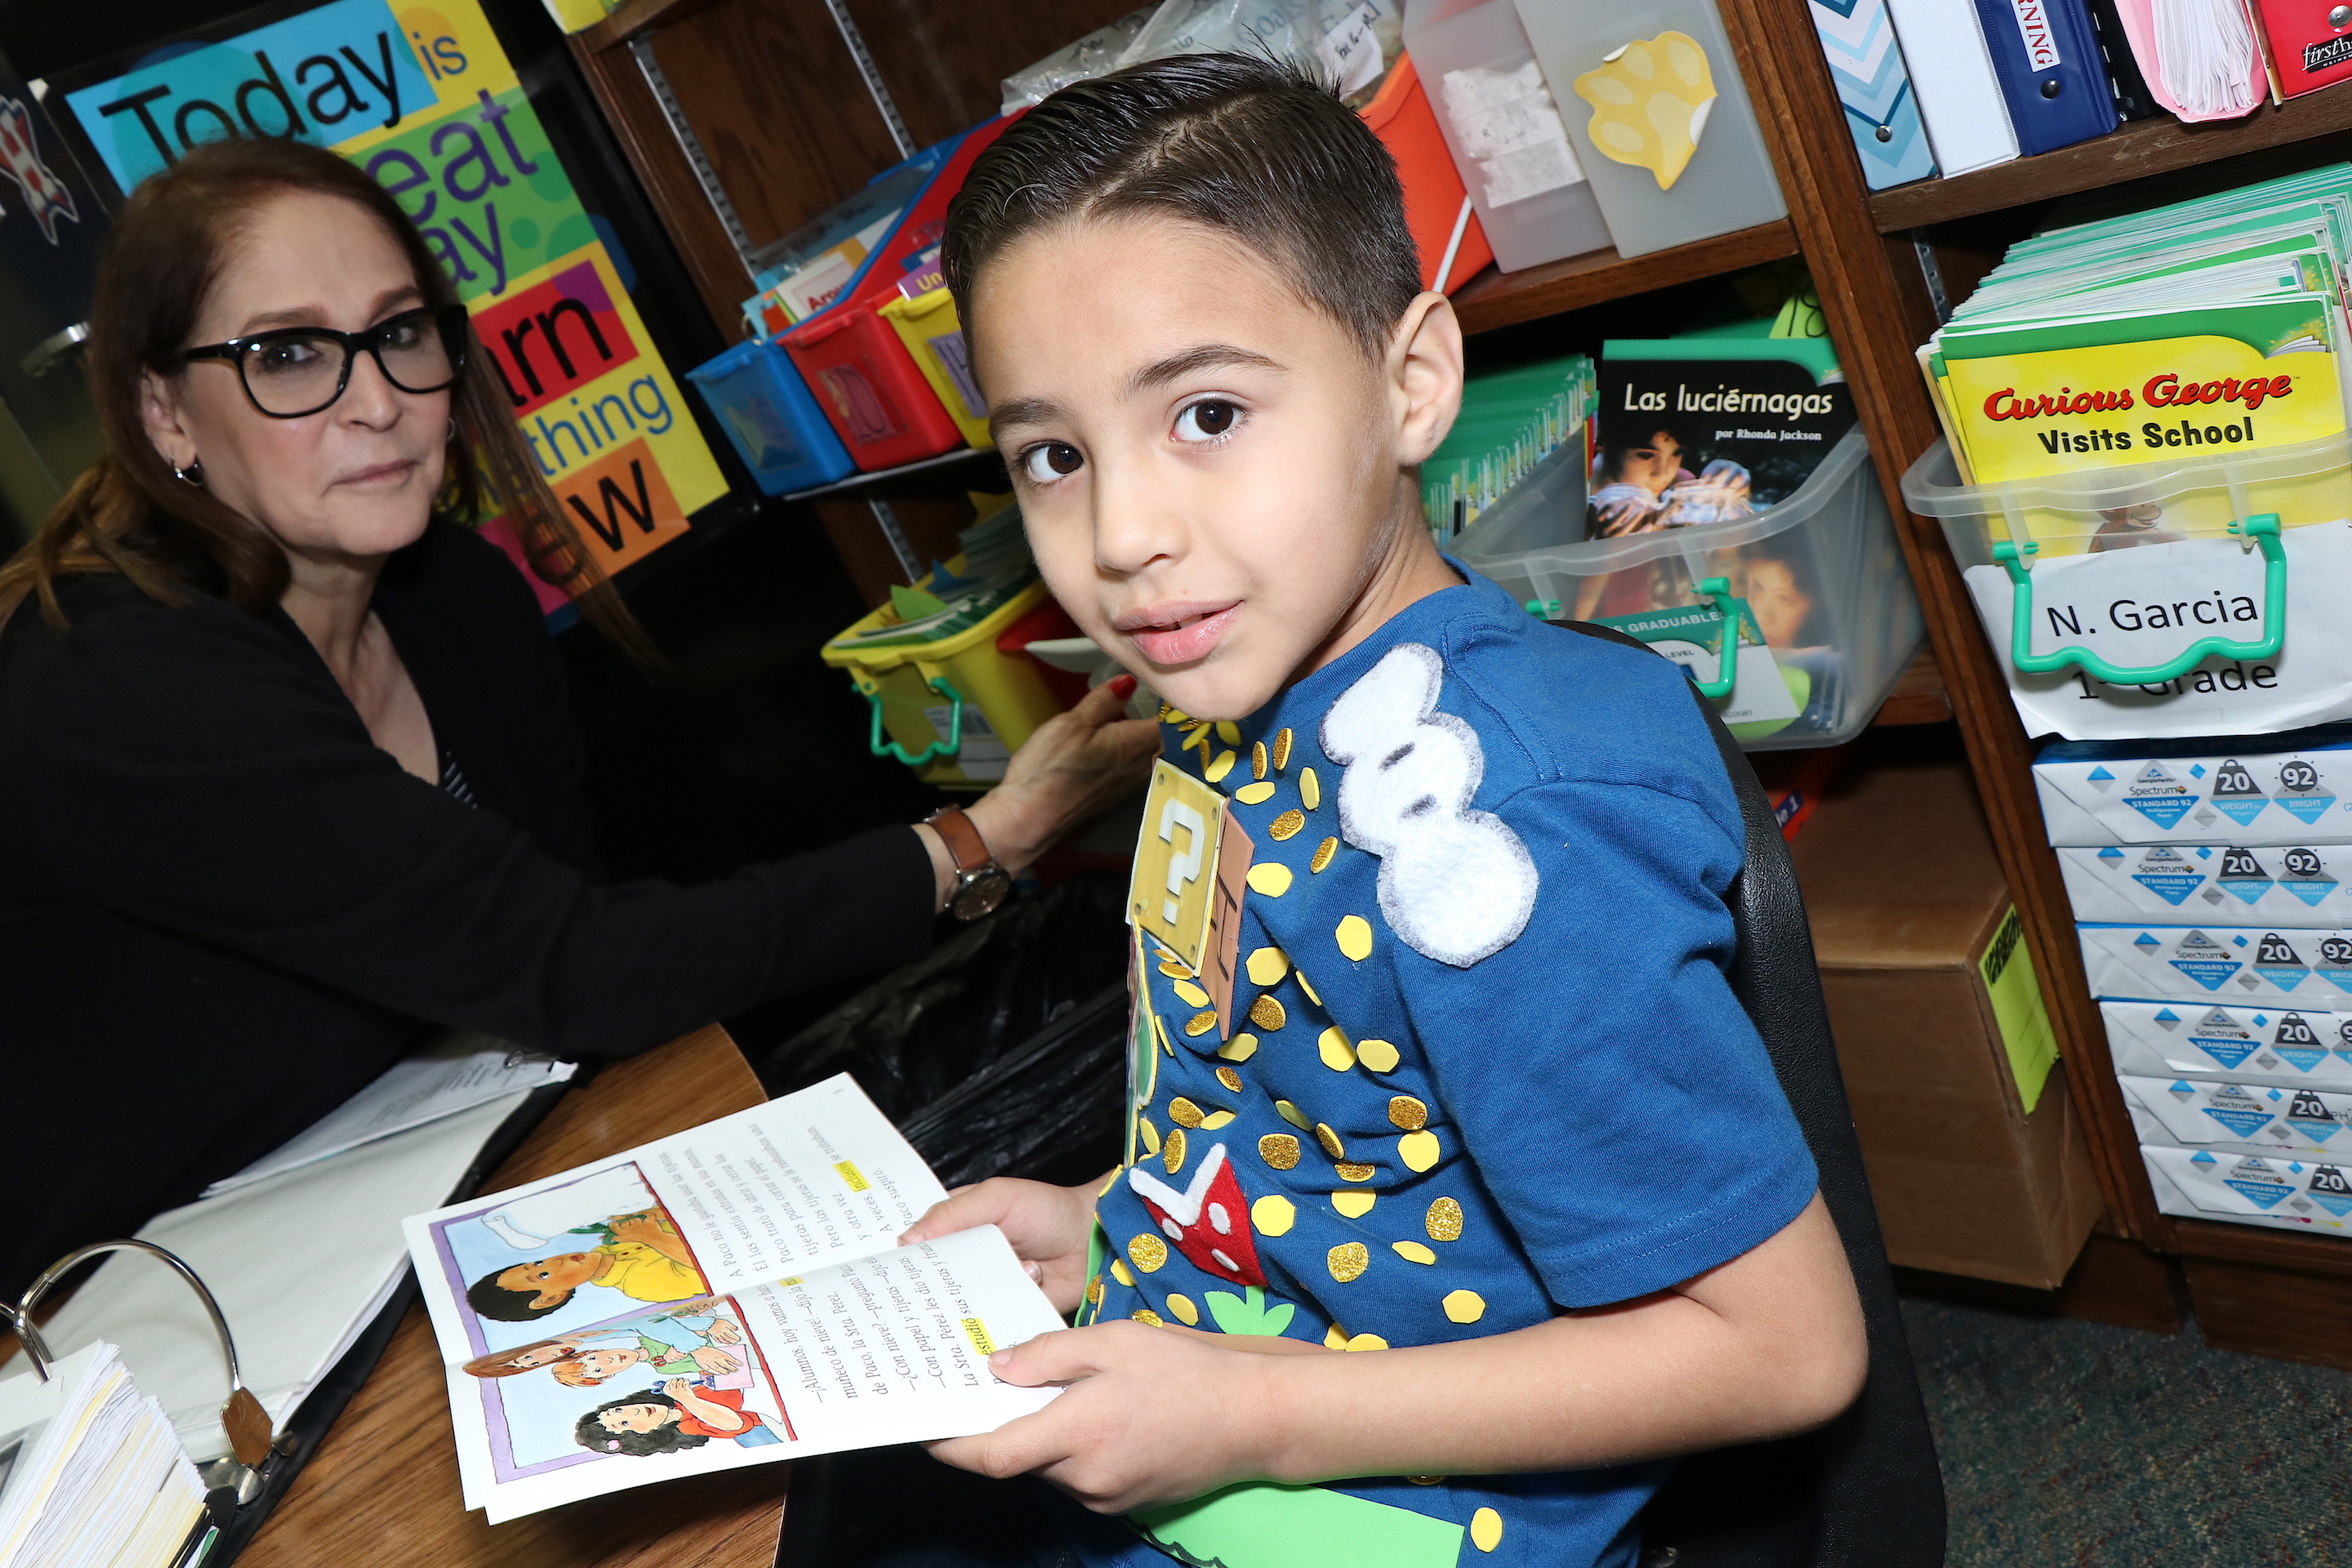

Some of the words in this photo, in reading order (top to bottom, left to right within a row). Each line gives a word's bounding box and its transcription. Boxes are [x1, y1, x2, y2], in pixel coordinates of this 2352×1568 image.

[2301, 37, 2352, 71] firsth
[99, 31, 400, 168] Today
[412, 33, 467, 81] is
[1624, 383, 1667, 412] Las
[1677, 383, 1833, 421] luciérnagas
[1984, 387, 2134, 422] Curious
[2141, 373, 2292, 410] George
[1714, 430, 1735, 442] por
[1736, 428, 1777, 440] Rhonda
[1779, 429, 1822, 443] Jackson
[2037, 427, 2132, 454] Visits
[2141, 416, 2255, 449] School
[2046, 605, 2096, 637] N.
[2109, 590, 2258, 632] Garcia
[2218, 772, 2251, 791] 20
[2282, 767, 2315, 786] 92
[2129, 786, 2177, 797] Spectrum
[2219, 802, 2254, 810] WEIGHT
[2288, 800, 2321, 808] BRIGHT
[2138, 864, 2185, 875] Spectrum
[2225, 855, 2256, 873] 20
[2287, 855, 2318, 871] 92
[2141, 877, 2186, 885] STANDARD
[2187, 877, 2198, 885] 92
[2292, 883, 2323, 891] BRIGHT
[2176, 950, 2223, 960] Spectrum
[2261, 943, 2292, 961] 20
[2323, 944, 2352, 960] 92
[2177, 963, 2223, 972] STANDARD
[2224, 964, 2236, 972] 92
[2261, 970, 2295, 978] WEIGHT
[2194, 1027, 2242, 1039] Spectrum
[2279, 1023, 2311, 1042] 20
[2197, 1040, 2241, 1050] STANDARD
[2243, 1043, 2255, 1051] 92
[2281, 1050, 2314, 1058] WEIGHT
[2209, 1098, 2255, 1110] Spectrum
[2293, 1099, 2324, 1116] 20
[2211, 1111, 2256, 1121] STANDARD
[709, 1152, 727, 1165] las
[666, 1173, 684, 1184] las
[735, 1180, 751, 1188] y
[755, 1174, 770, 1183] el
[833, 1160, 866, 1193] inclusive
[867, 1166, 902, 1200] suspiró.
[2314, 1173, 2345, 1192] 20
[763, 1182, 786, 1201] cortar
[793, 1182, 822, 1208] tijeras
[829, 1190, 848, 1207] vez.
[748, 1204, 765, 1215] de
[778, 1200, 803, 1222] para
[862, 1192, 885, 1220] veces,
[891, 1200, 916, 1227] Paco
[809, 1208, 829, 1224] las
[840, 1208, 862, 1231] otra
[725, 1214, 752, 1241] sentía
[755, 1214, 779, 1237] trató
[876, 1223, 893, 1235] A
[708, 1229, 724, 1242] no
[790, 1221, 822, 1256] tijeras
[818, 1223, 844, 1250] Pero
[856, 1232, 872, 1241] y
[712, 1242, 737, 1267] Paco
[742, 1241, 761, 1258] las
[769, 1237, 794, 1264] Paco
[726, 1267, 743, 1280] A
[748, 1258, 768, 1272] Él
[897, 1254, 922, 1281] tijeras.
[788, 1285, 804, 1294] la
[913, 1280, 931, 1294] dio
[936, 1267, 962, 1296] tijeras
[826, 1290, 848, 1314] Pérez.
[885, 1285, 911, 1314] tijeras
[924, 1296, 940, 1310] les
[954, 1297, 972, 1314] sus
[767, 1301, 789, 1325] vamos
[804, 1316, 831, 1343] nieve!
[842, 1315, 860, 1338] Srta.
[932, 1312, 956, 1340] Pérez
[781, 1329, 799, 1344] hoy
[850, 1337, 866, 1349] la
[871, 1322, 900, 1352] nieve?
[903, 1324, 937, 1353] papel
[960, 1316, 992, 1356] estudió
[820, 1343, 838, 1356] de
[949, 1343, 970, 1368] Srta.
[860, 1352, 881, 1378] Paco,
[830, 1359, 858, 1399] muñeco
[963, 1371, 979, 1385] La
[871, 1381, 889, 1394] de
